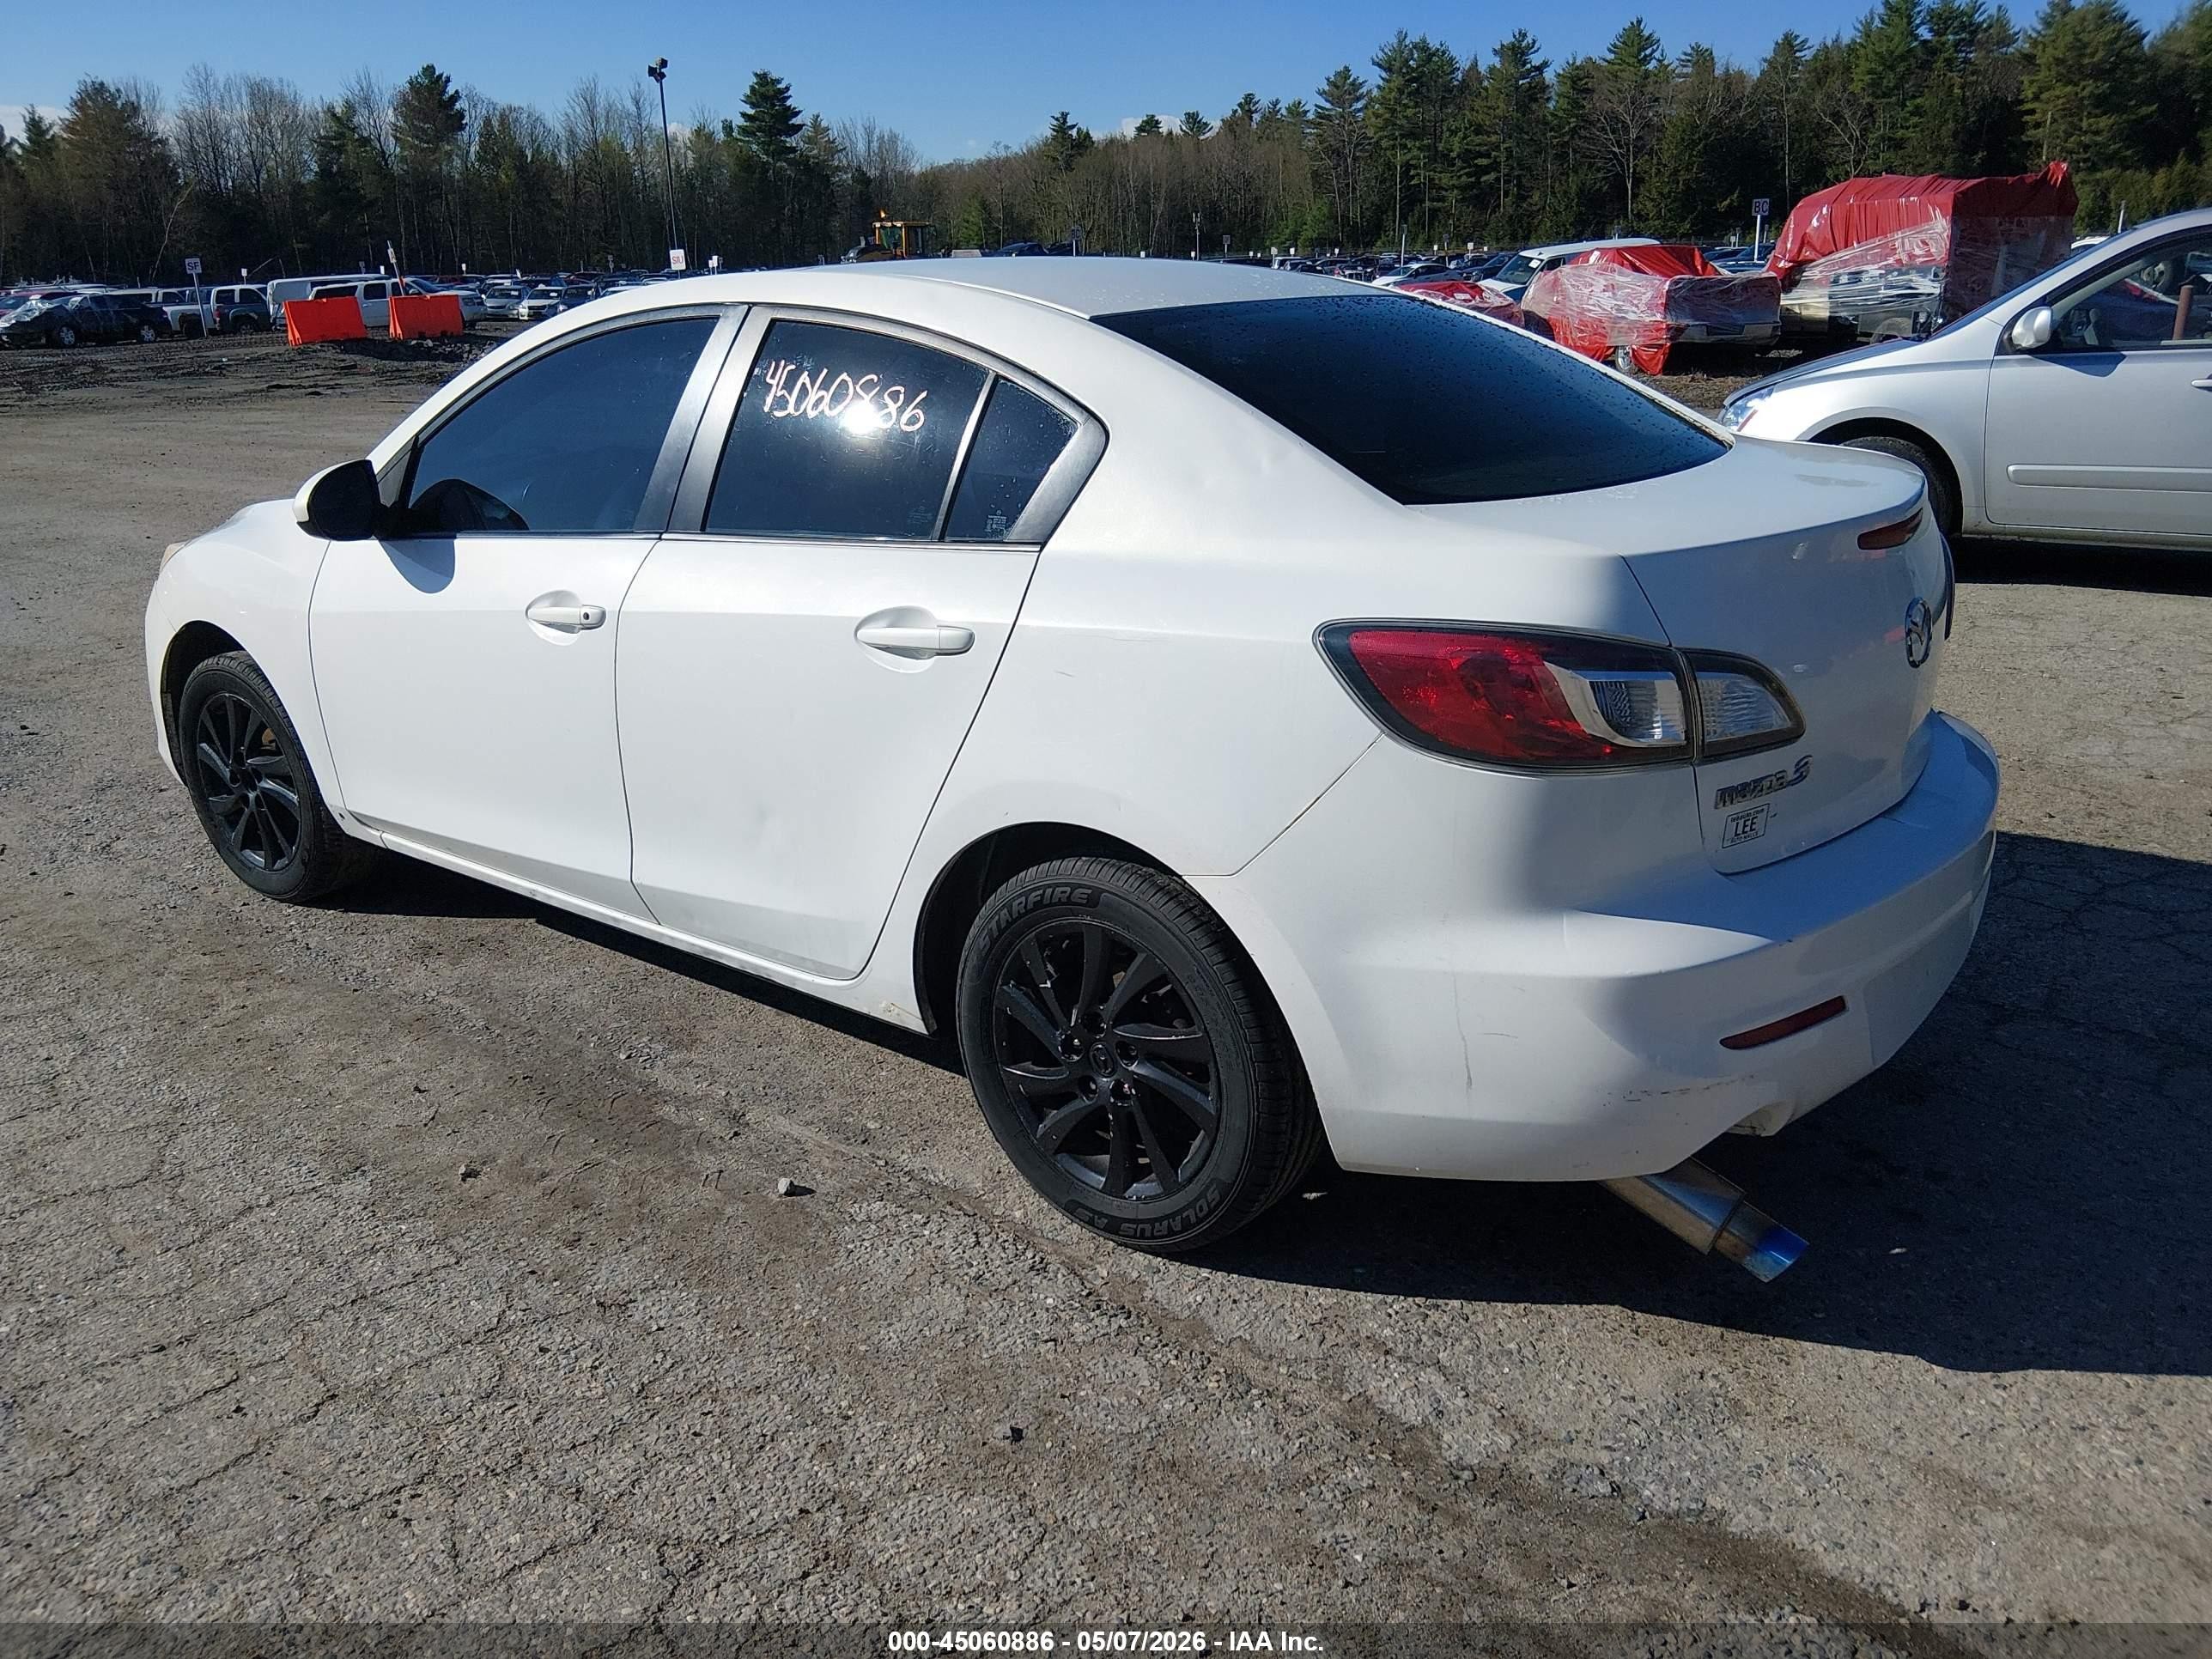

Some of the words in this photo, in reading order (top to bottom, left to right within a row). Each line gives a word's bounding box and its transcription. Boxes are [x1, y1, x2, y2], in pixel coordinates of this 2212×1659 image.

[1753, 200, 1769, 214] BC
[187, 260, 200, 271] SF
[763, 359, 928, 432] 45060886
[1735, 816, 1759, 837] LEE
[975, 886, 1093, 957] STARFIRE
[1118, 1185, 1221, 1237] SOLARUS
